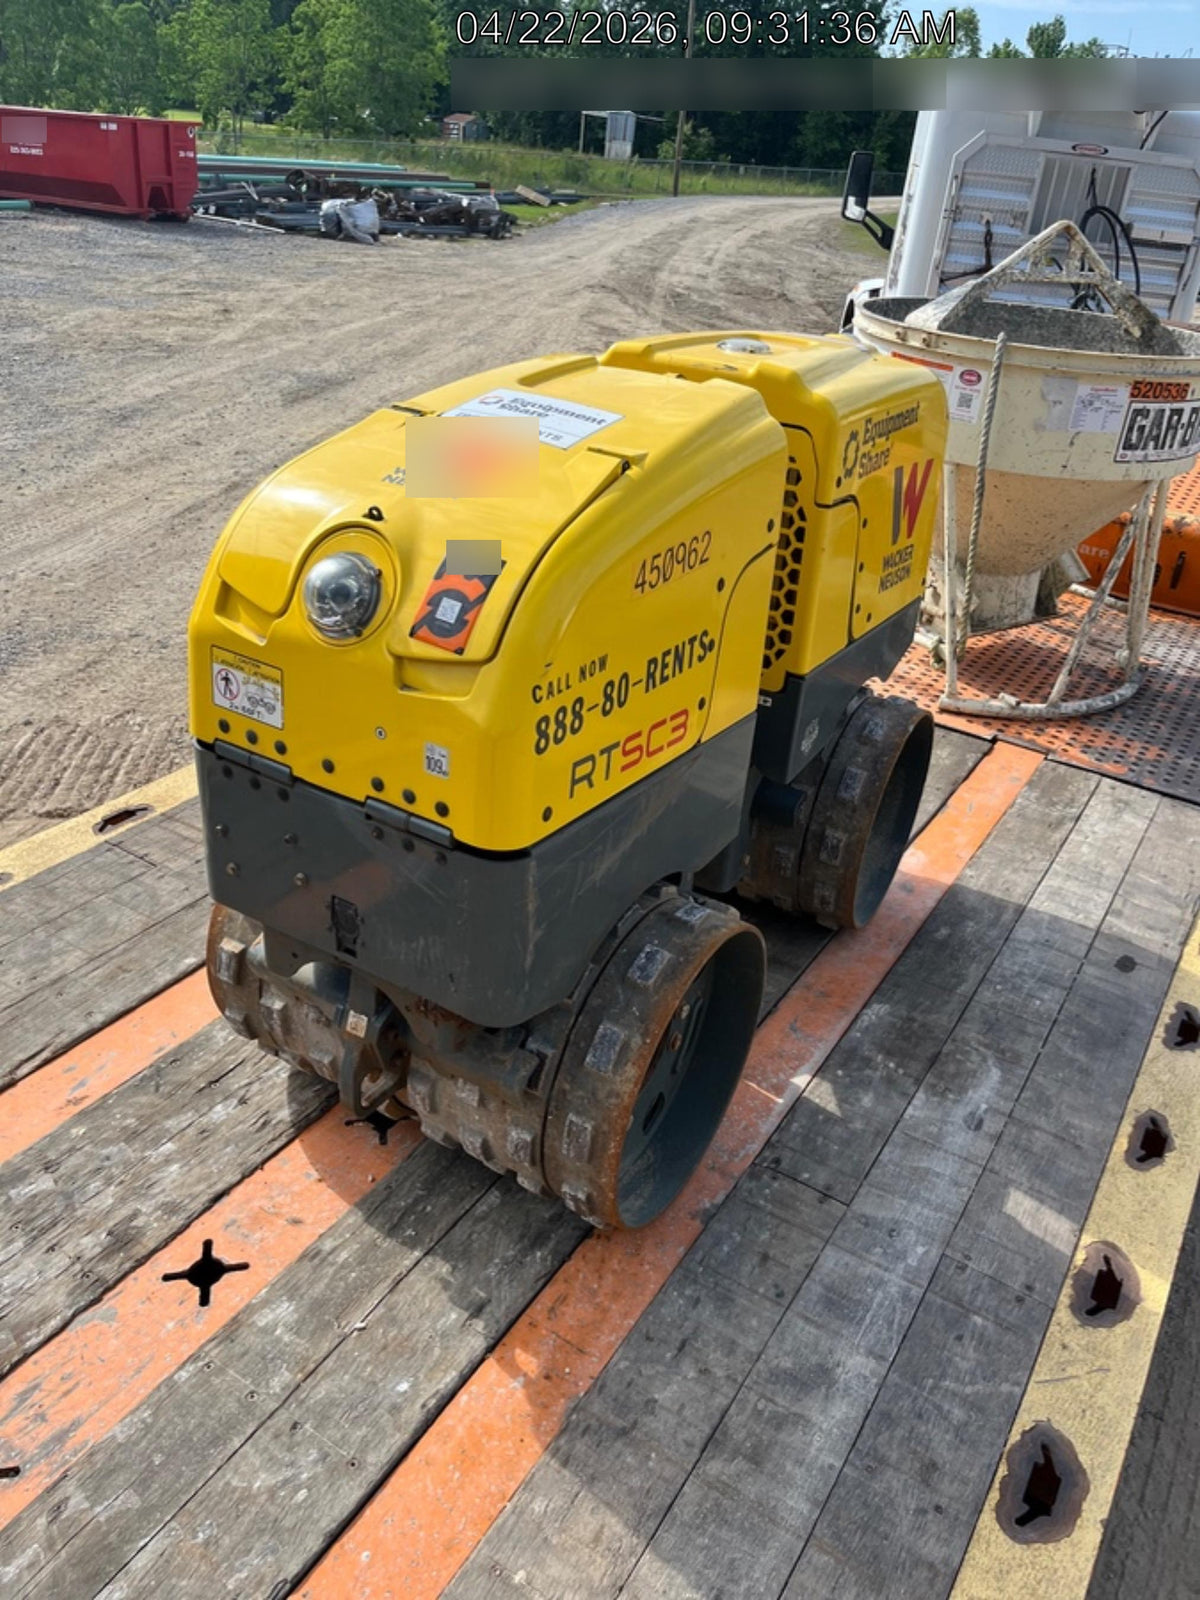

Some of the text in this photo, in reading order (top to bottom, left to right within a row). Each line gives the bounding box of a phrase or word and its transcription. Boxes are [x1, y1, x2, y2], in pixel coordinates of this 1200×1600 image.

[1130, 379, 1190, 399] 520536
[498, 402, 550, 418] Share
[509, 397, 607, 425] Equipment
[862, 400, 920, 447] Equipment
[858, 447, 890, 480] Share
[634, 530, 712, 594] 450962
[882, 544, 914, 574] WACKER
[878, 564, 911, 595] NEUSON
[532, 654, 609, 704] CALL NOW
[534, 629, 709, 756] 888-80-RENTS
[569, 708, 689, 799] RTSC3
